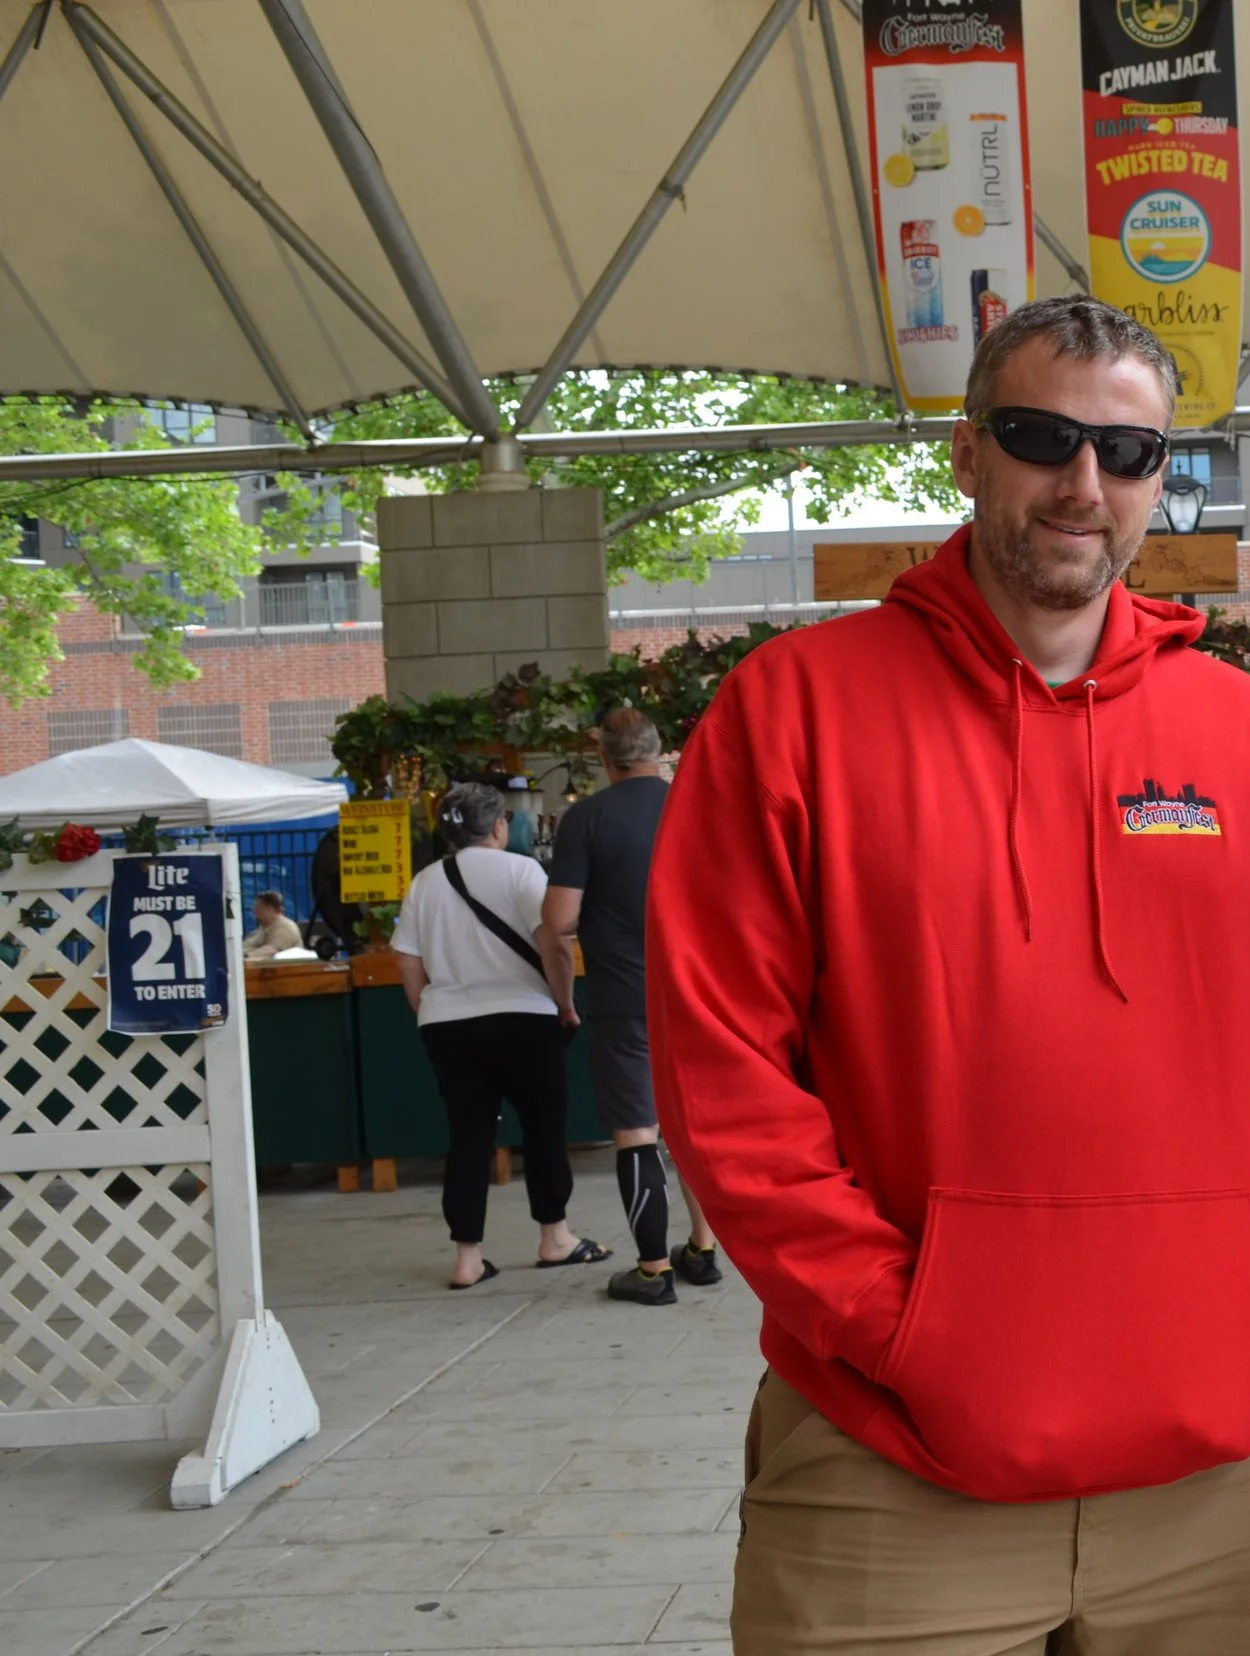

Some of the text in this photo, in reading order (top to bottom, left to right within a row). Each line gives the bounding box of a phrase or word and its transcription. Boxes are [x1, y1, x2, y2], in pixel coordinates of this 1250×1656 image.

[1100, 50, 1217, 97] CAYMAN JACK
[1094, 116, 1229, 138] HAPPY THURSDAY
[1096, 149, 1228, 186] TWISTED TEA
[1147, 200, 1181, 213] SUN
[1130, 216, 1200, 230] CRUISER
[910, 258, 932, 269] ICE
[1159, 800, 1186, 808] Wayne
[147, 865, 190, 890] Lite
[133, 896, 196, 912] MUST BE
[129, 912, 206, 982] 21
[134, 984, 206, 1001] TO ENTER
